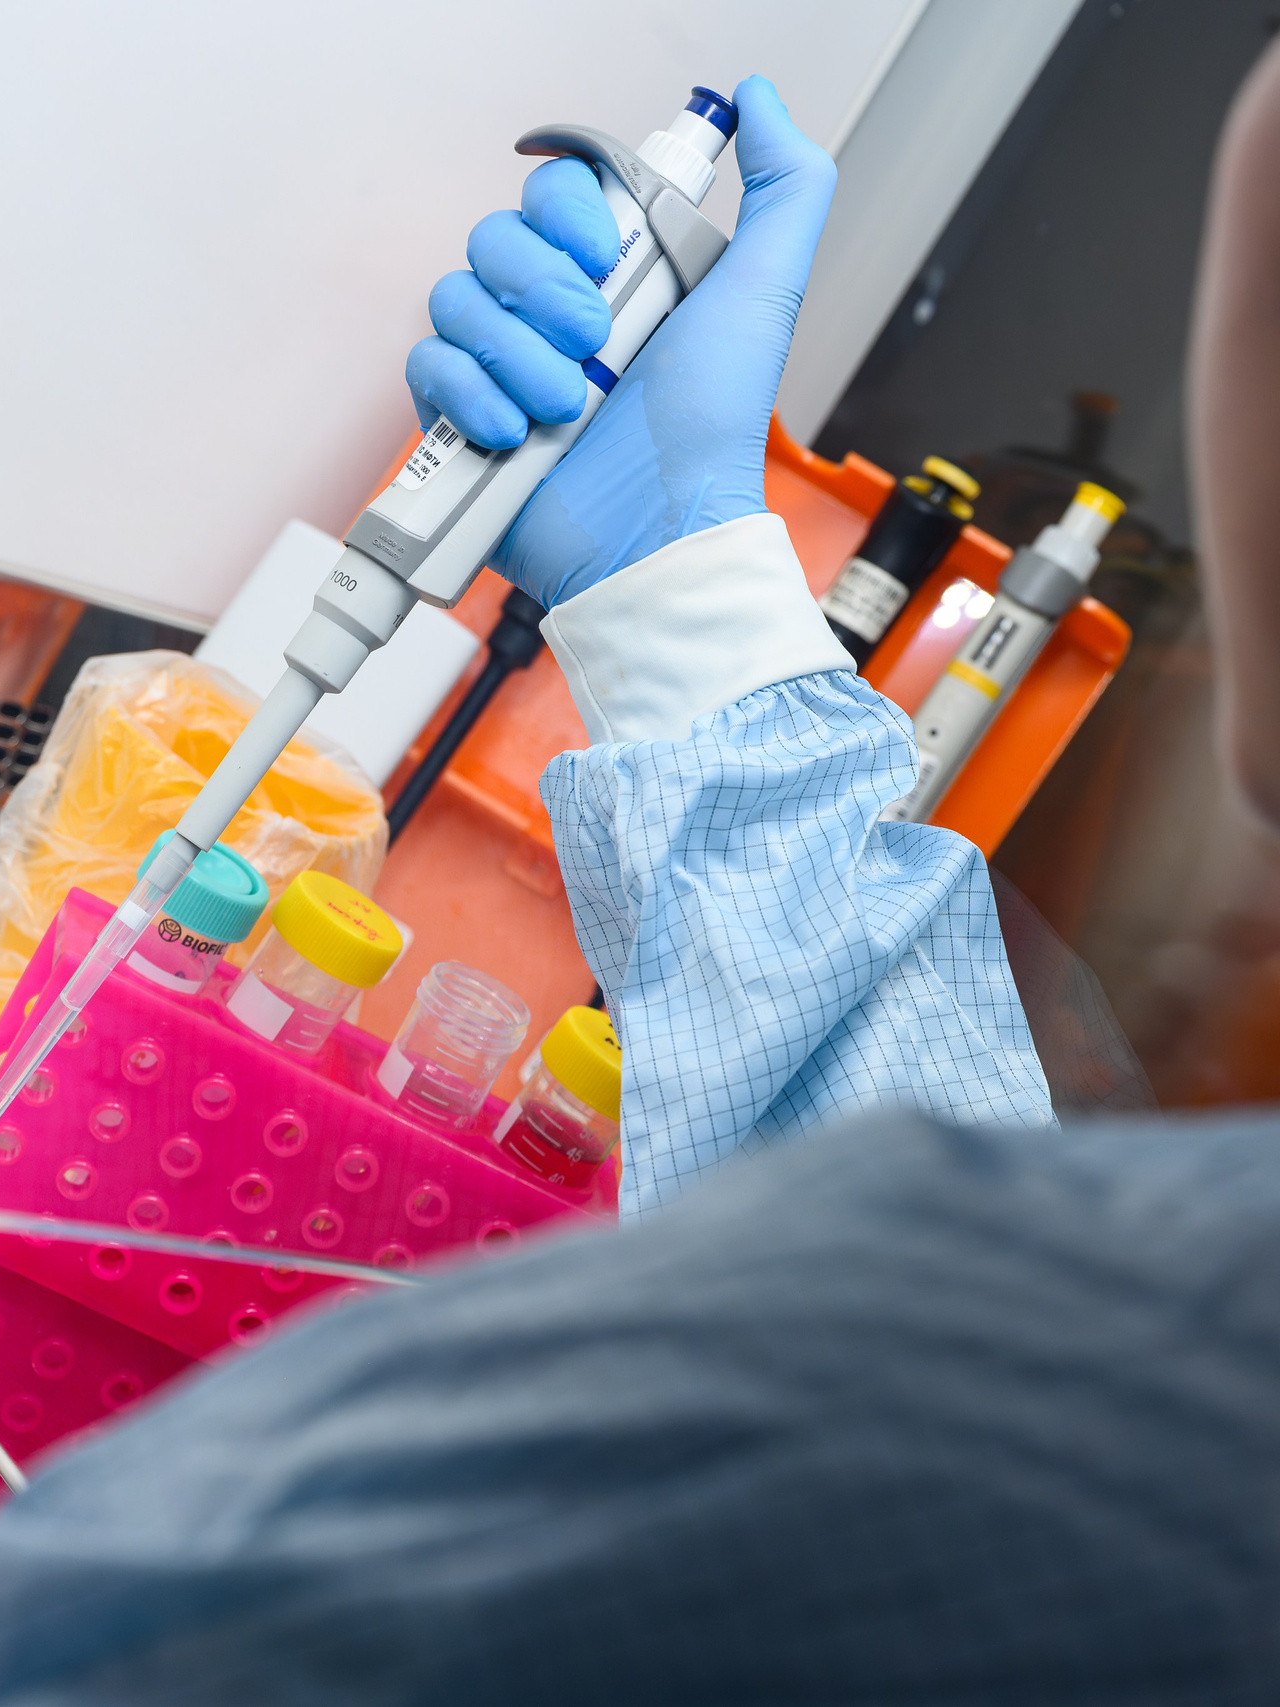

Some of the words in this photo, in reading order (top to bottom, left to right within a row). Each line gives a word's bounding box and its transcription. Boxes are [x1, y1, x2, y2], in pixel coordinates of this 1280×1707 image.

[620, 229, 641, 258] plus
[421, 449, 441, 468] МФТИ
[372, 538, 402, 562] Germany
[378, 531, 397, 548] Made
[330, 569, 357, 592] 1000
[181, 934, 224, 956] BIOFIL
[566, 1147, 583, 1162] 45
